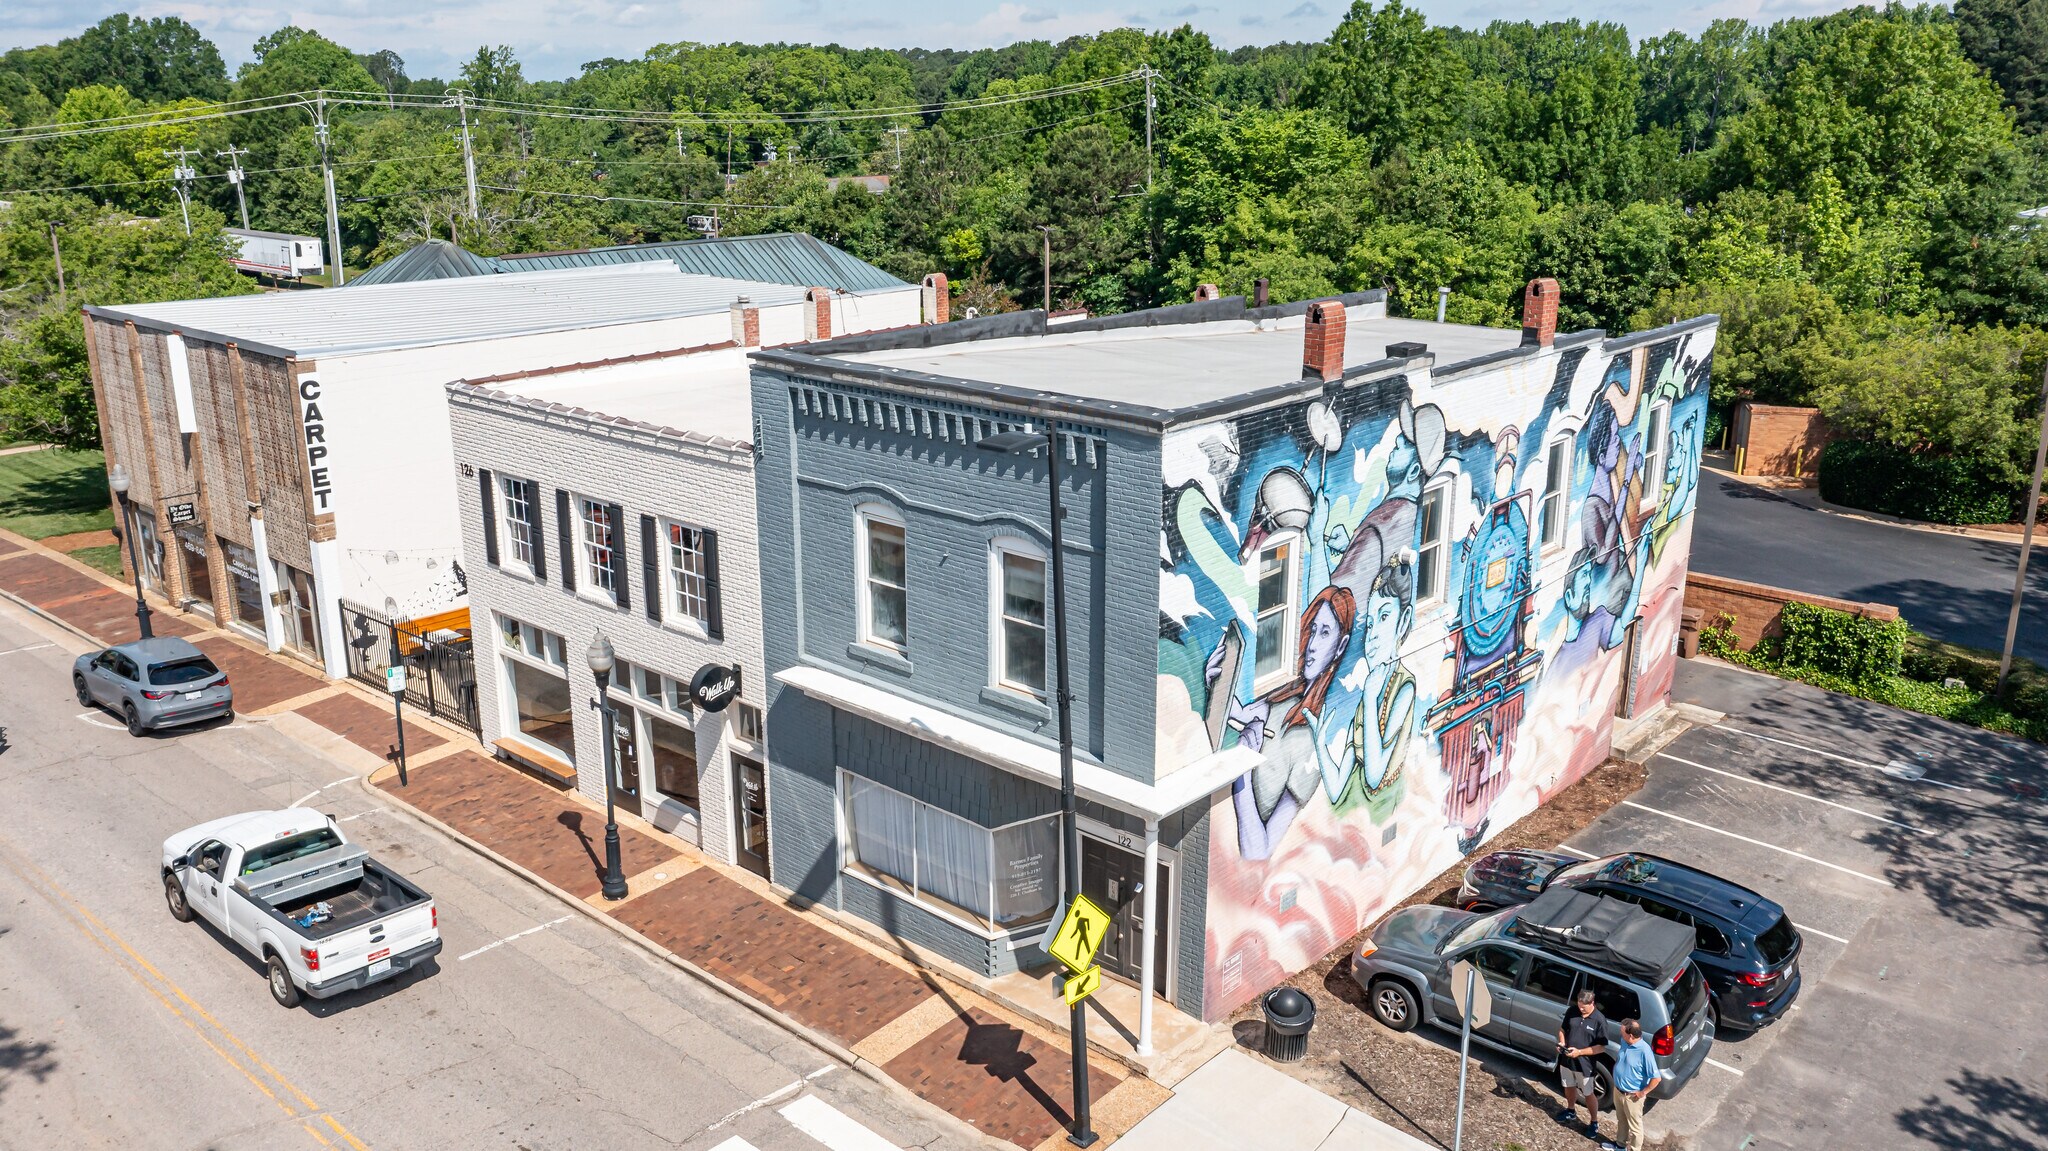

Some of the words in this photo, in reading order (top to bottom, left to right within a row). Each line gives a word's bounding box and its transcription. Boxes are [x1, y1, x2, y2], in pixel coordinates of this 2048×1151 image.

[300, 380, 332, 509] CARPET
[460, 462, 474, 478] 126
[172, 514, 193, 522] Shoppe
[699, 681, 723, 701] Walk
[723, 676, 735, 691] Up
[1118, 834, 1132, 848] 122
[1014, 861, 1039, 869] Properties
